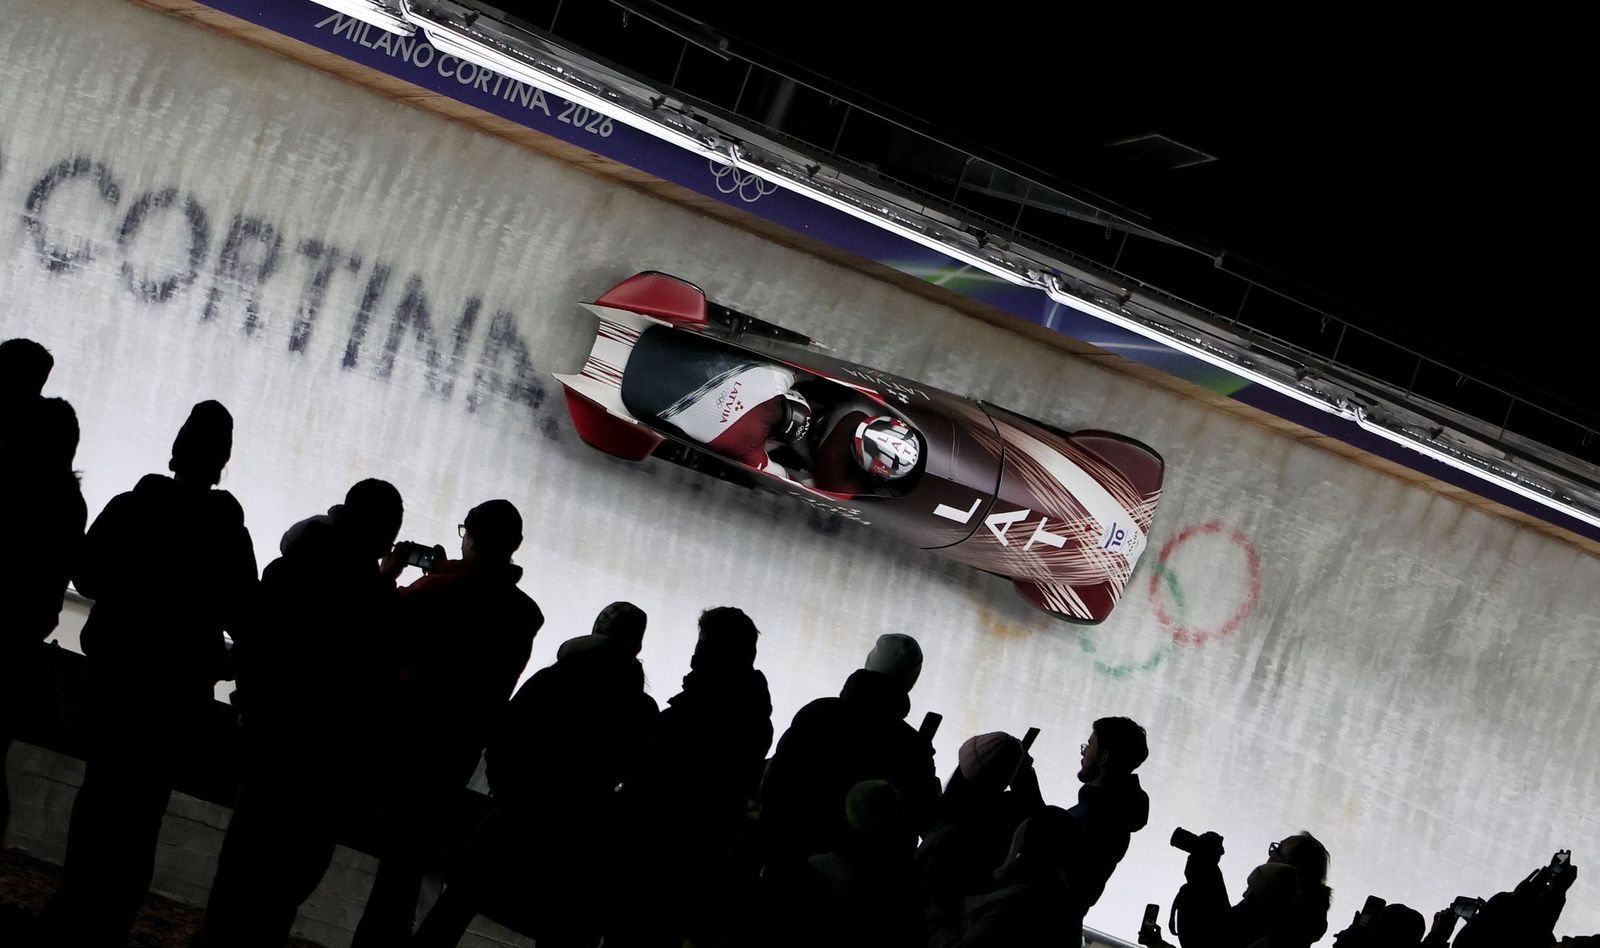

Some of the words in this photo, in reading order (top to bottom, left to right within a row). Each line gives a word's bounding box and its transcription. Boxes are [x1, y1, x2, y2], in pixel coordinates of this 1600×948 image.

[314, 12, 435, 68] MILANO
[437, 48, 551, 117] CORTINA
[557, 101, 614, 138] 2026
[24, 156, 562, 441] CORTINA
[933, 498, 1068, 551] LAT
[1111, 529, 1125, 546] 10
